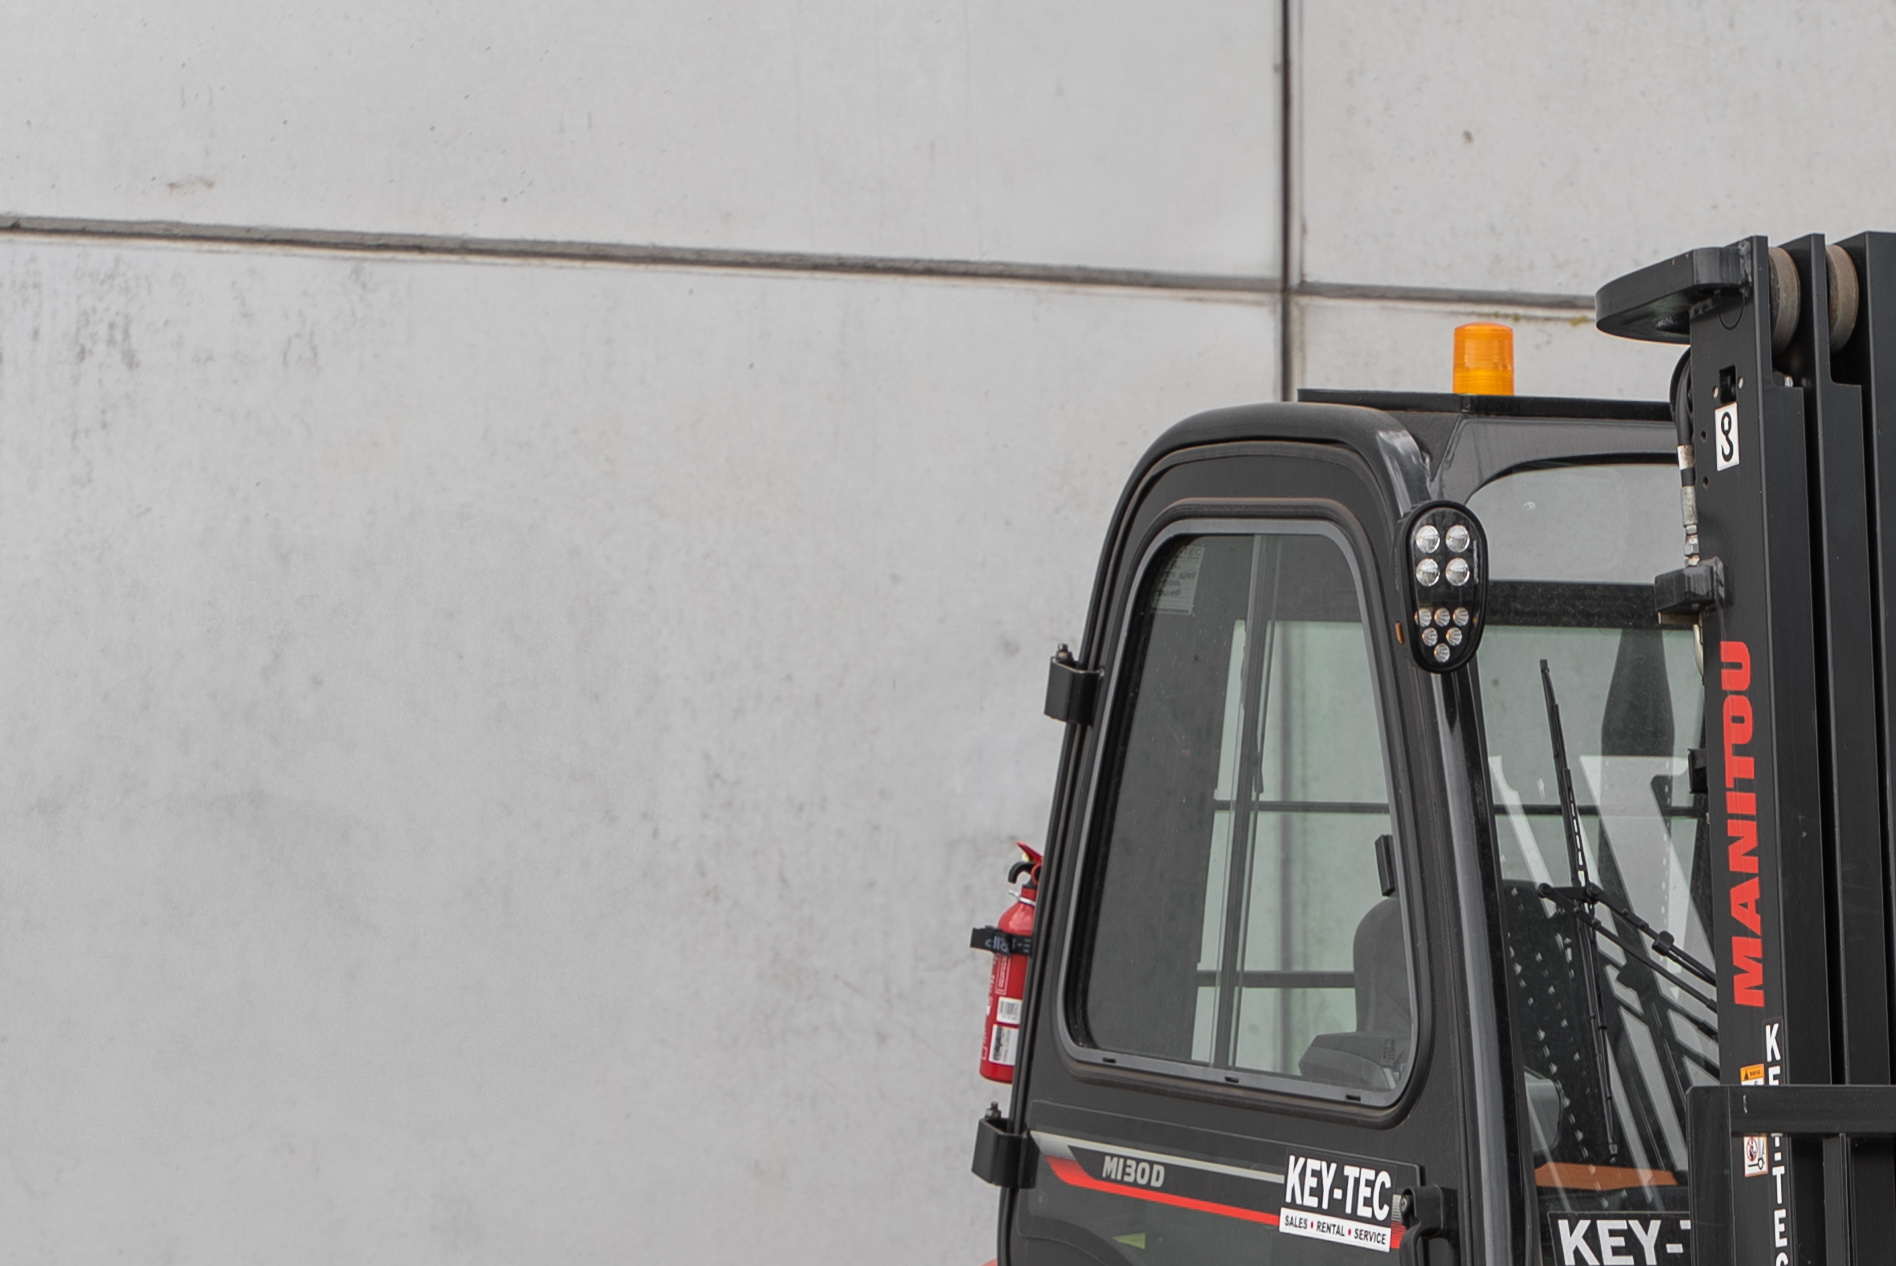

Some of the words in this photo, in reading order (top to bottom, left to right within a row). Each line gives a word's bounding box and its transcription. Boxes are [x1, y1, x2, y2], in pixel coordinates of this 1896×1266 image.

[1719, 640, 1765, 1008] MANITOU
[1285, 1154, 1392, 1221] KEY-TEC
[1284, 1214, 1309, 1230] SALES
[1315, 1220, 1346, 1238] RENTAL
[1353, 1227, 1387, 1246] SERVICE
[1557, 1219, 1691, 1266] KEY-
